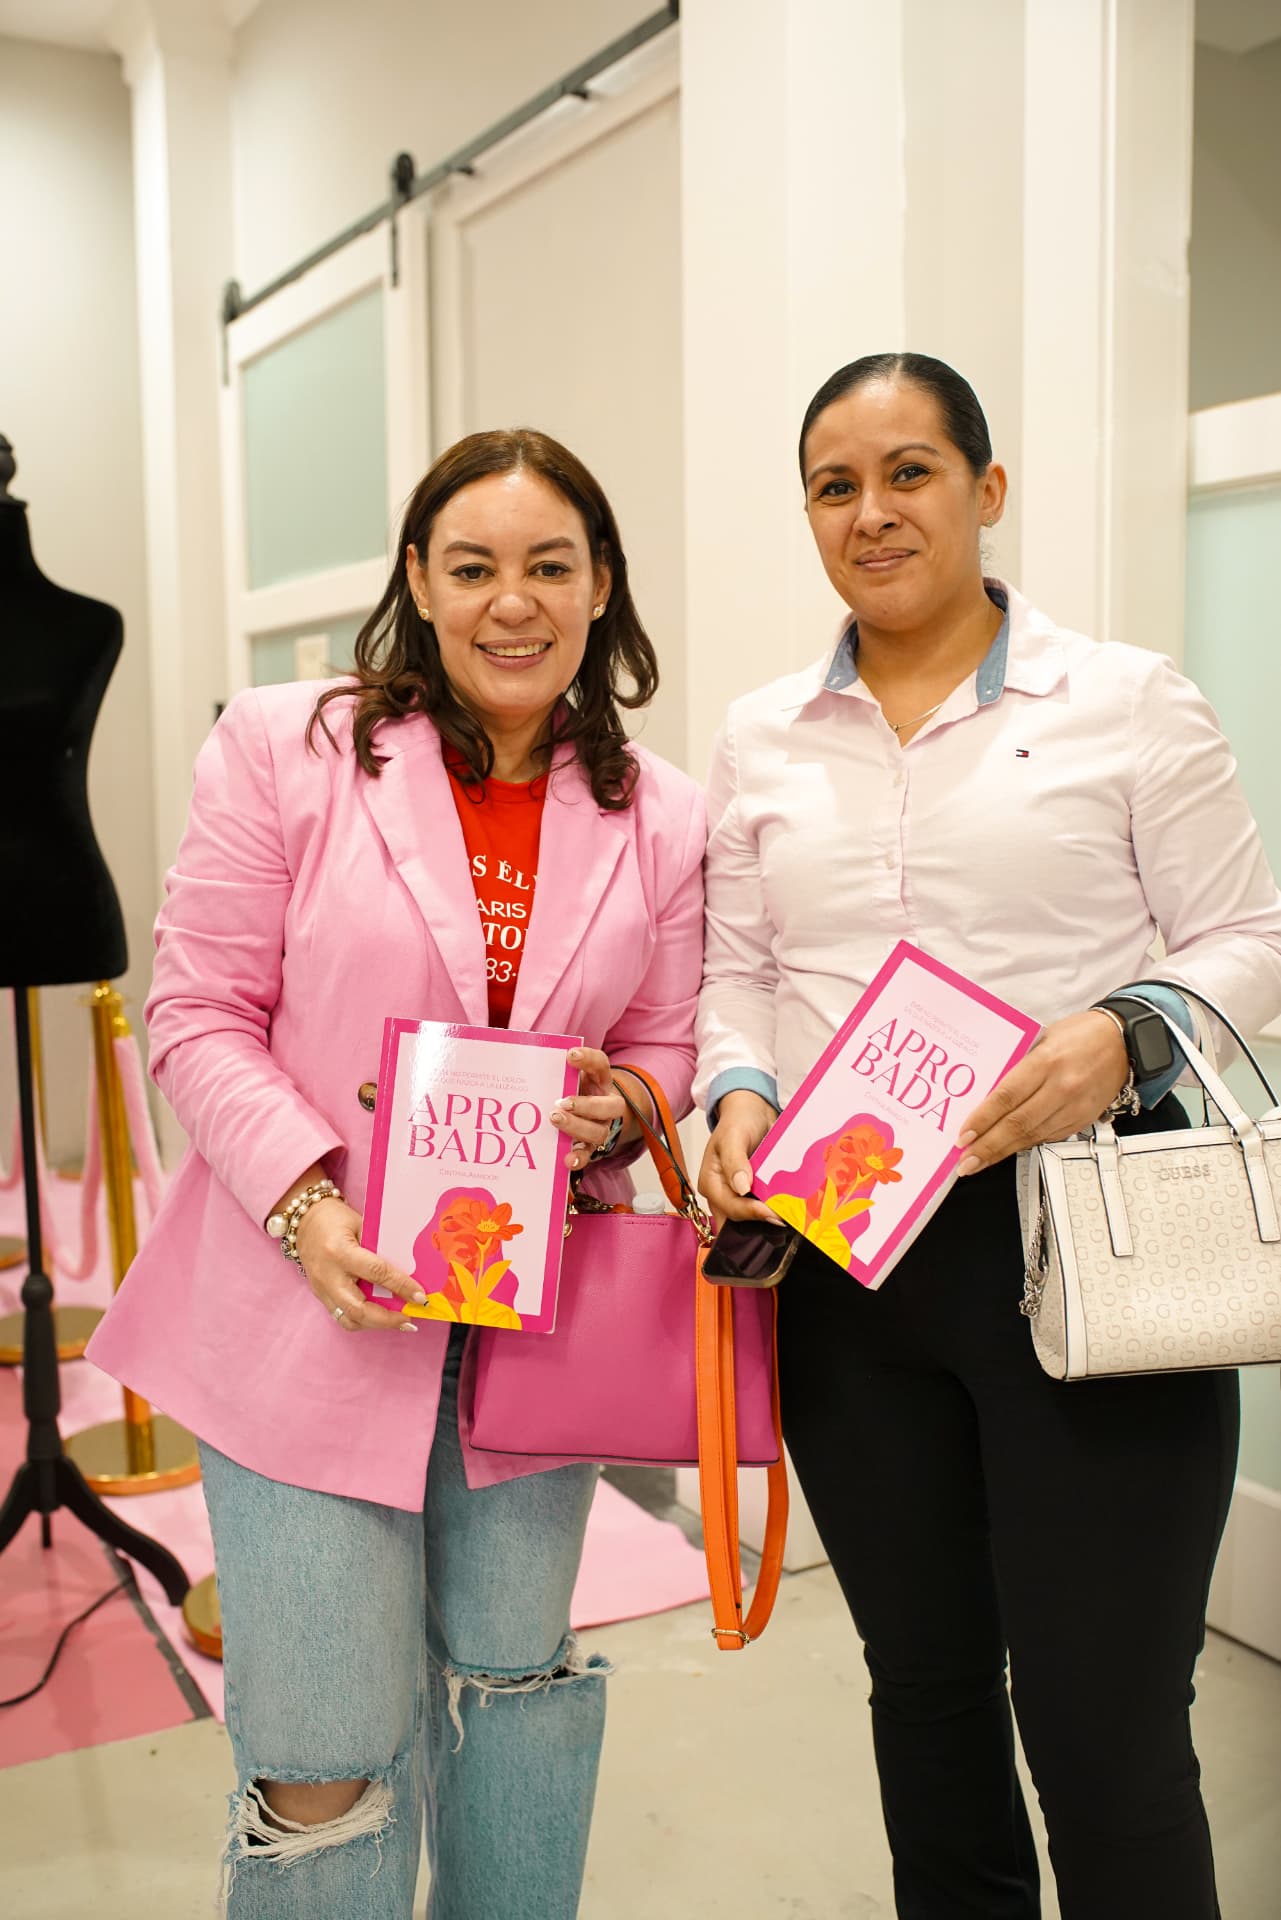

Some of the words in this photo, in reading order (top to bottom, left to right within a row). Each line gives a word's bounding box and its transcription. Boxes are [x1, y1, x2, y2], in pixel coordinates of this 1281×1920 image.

[496, 860, 537, 891] ÉL
[482, 922, 528, 952] TO
[867, 1018, 975, 1097] APRO
[851, 1041, 951, 1132] BADA
[408, 1093, 542, 1135] APRO
[408, 1125, 537, 1170] BADA
[1159, 1164, 1210, 1181] GUESS
